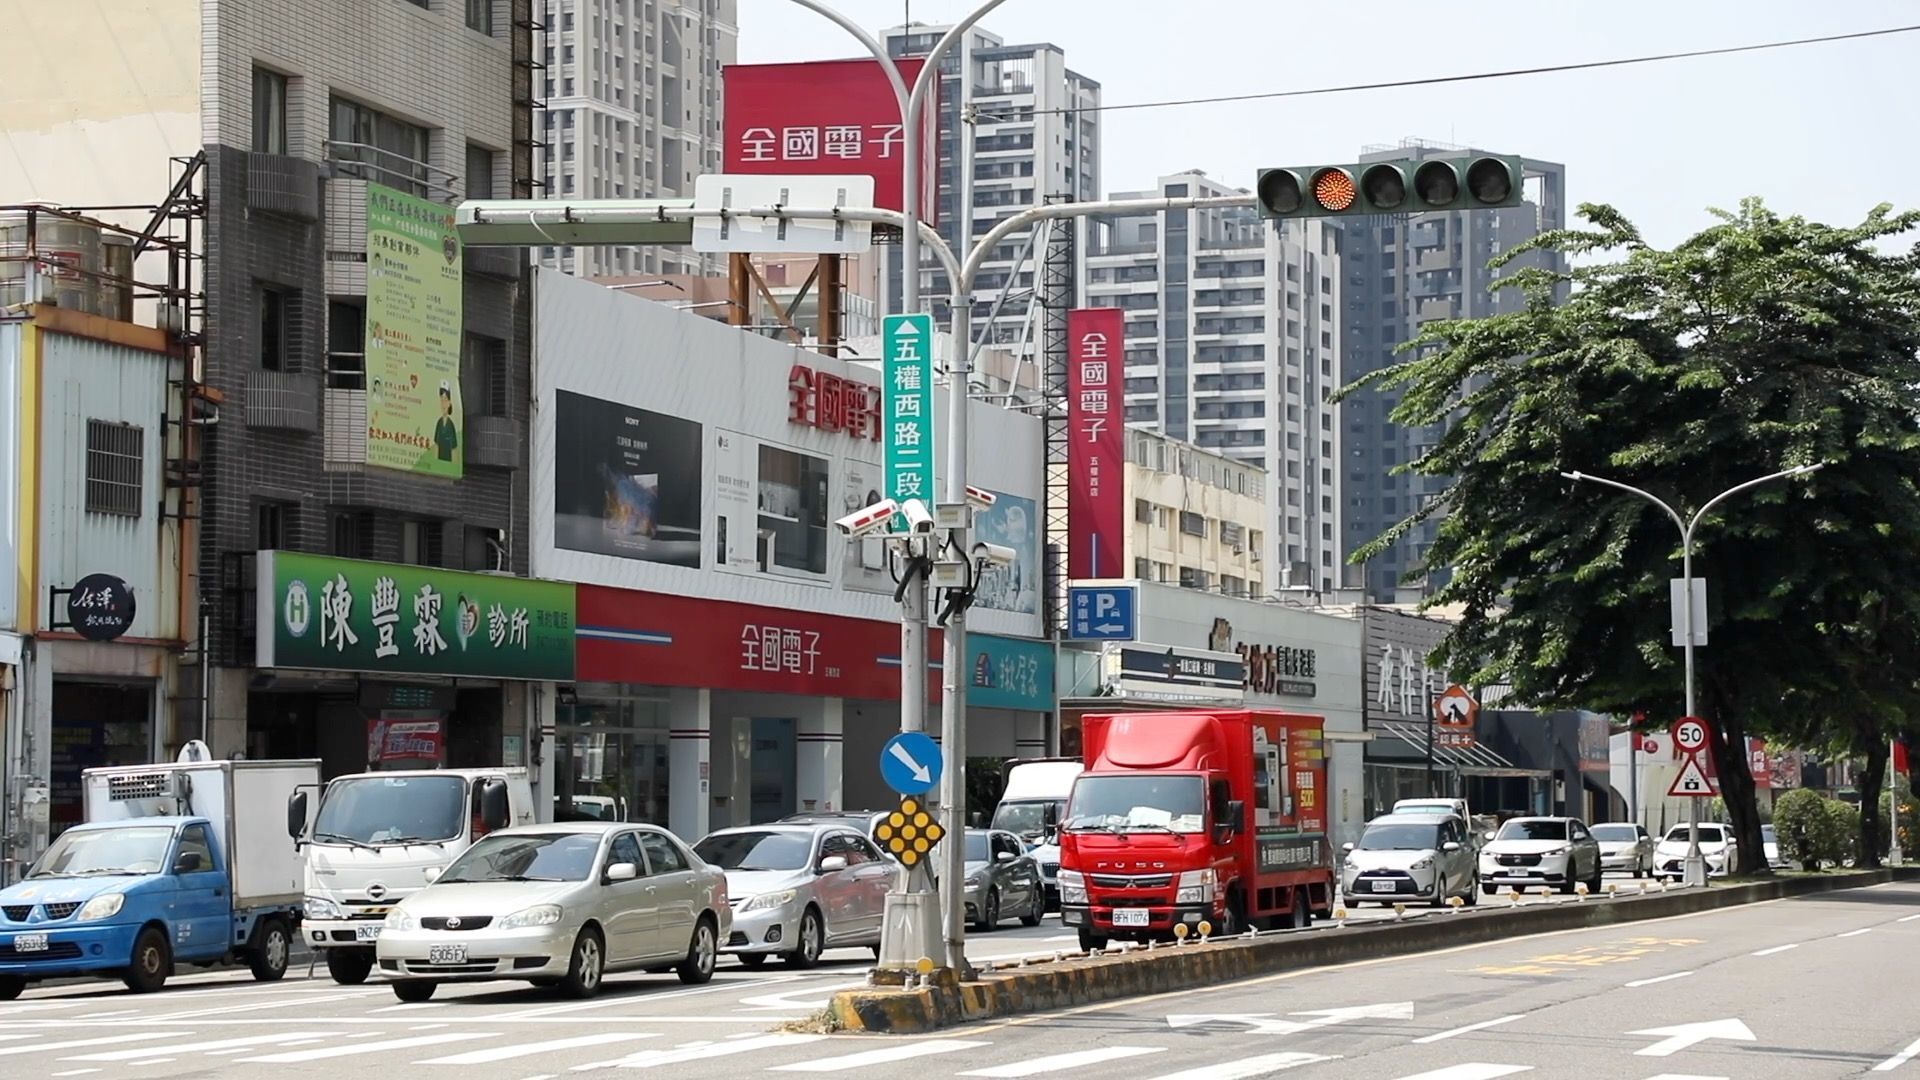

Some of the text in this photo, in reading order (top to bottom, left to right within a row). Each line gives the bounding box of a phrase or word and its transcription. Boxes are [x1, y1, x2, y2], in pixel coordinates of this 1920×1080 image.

[741, 124, 904, 161] 全國電子
[1081, 333, 1108, 443] 全國電子
[625, 416, 639, 426] SONY
[894, 338, 922, 497] 五權西路二段
[1090, 456, 1099, 496] 五權西店
[1077, 594, 1089, 634] 停車場
[1096, 593, 1116, 618] P
[741, 624, 821, 675] 全國電子
[1680, 728, 1702, 743] 50
